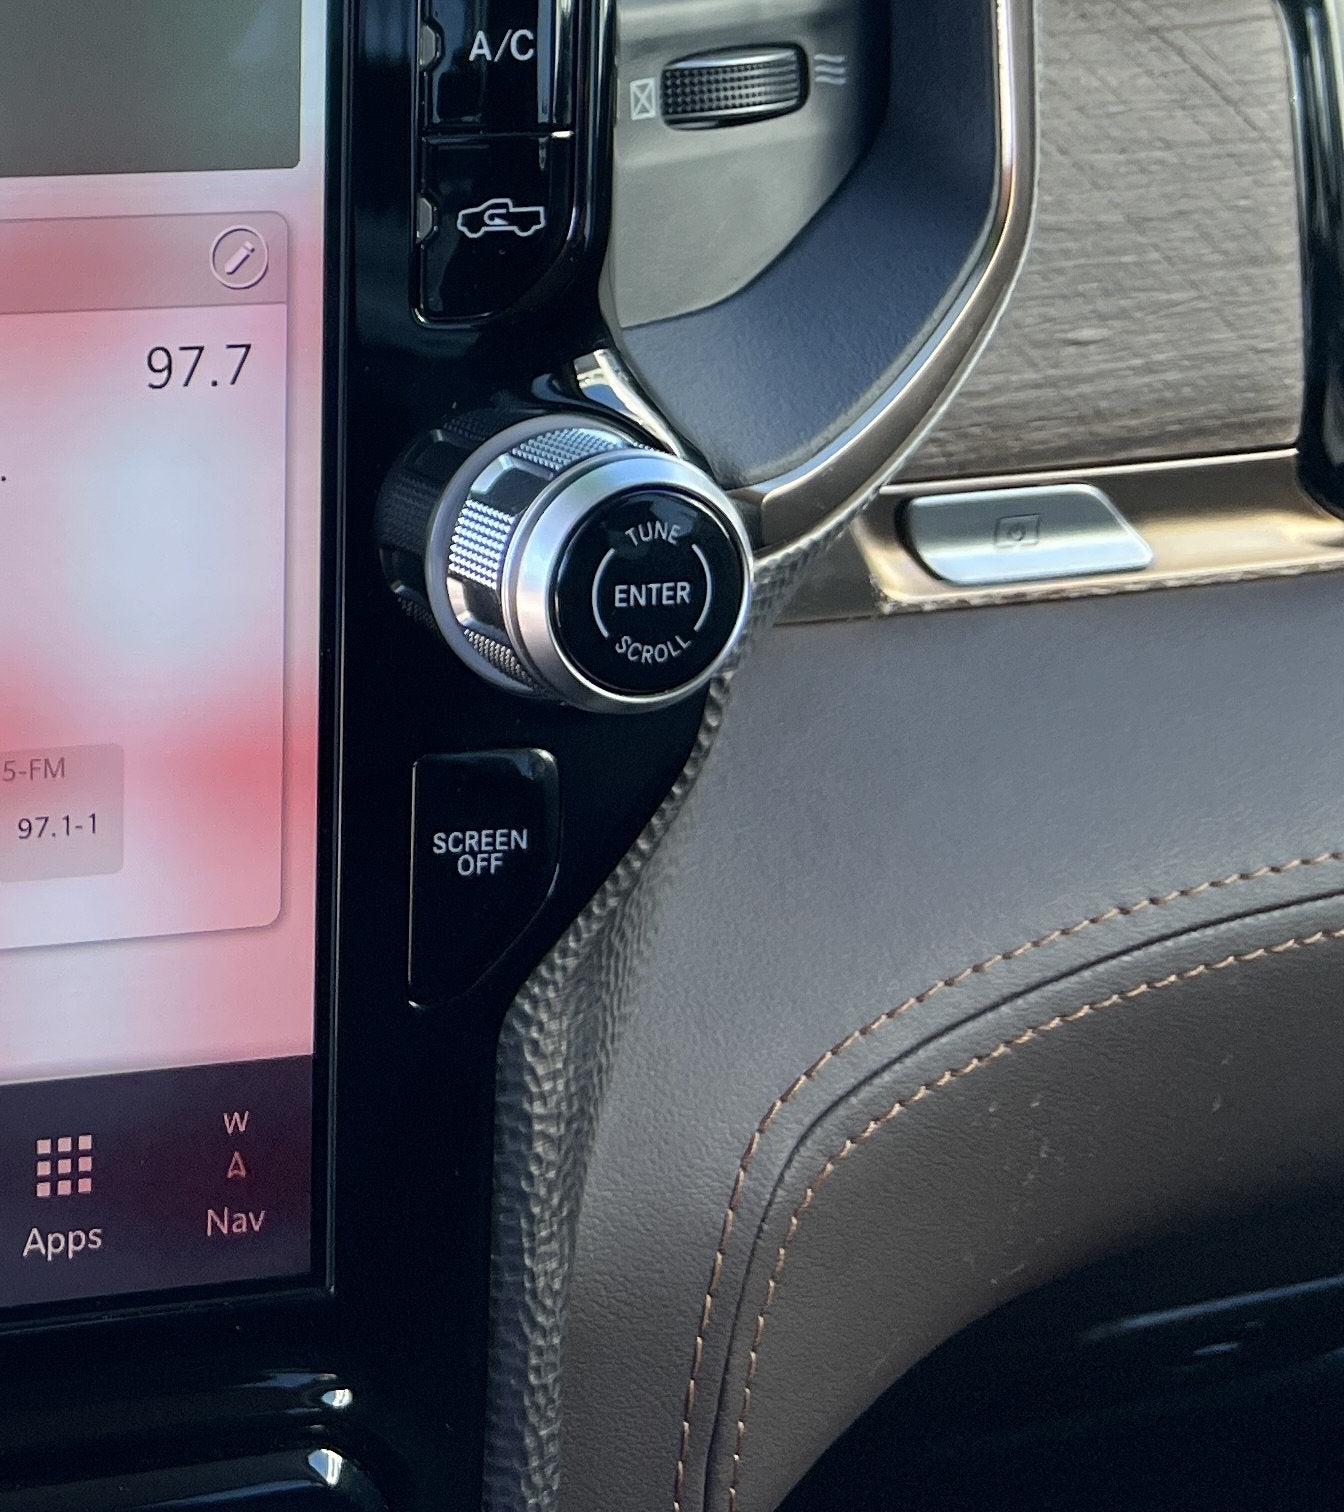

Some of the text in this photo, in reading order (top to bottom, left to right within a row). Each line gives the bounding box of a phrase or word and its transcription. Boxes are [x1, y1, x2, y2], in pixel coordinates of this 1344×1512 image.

[468, 28, 536, 64] A/C
[145, 342, 254, 393] 97.7
[624, 521, 682, 548] TUNE
[613, 580, 692, 609] ENTER
[614, 634, 693, 665] SCROLL
[2, 756, 68, 784] 5-FM
[16, 812, 100, 842] 97.1-1
[432, 828, 529, 855] SCREEN
[457, 852, 504, 877] OFF
[222, 1110, 250, 1136] W
[206, 1208, 265, 1238] Nav
[21, 1224, 104, 1261] Apps
